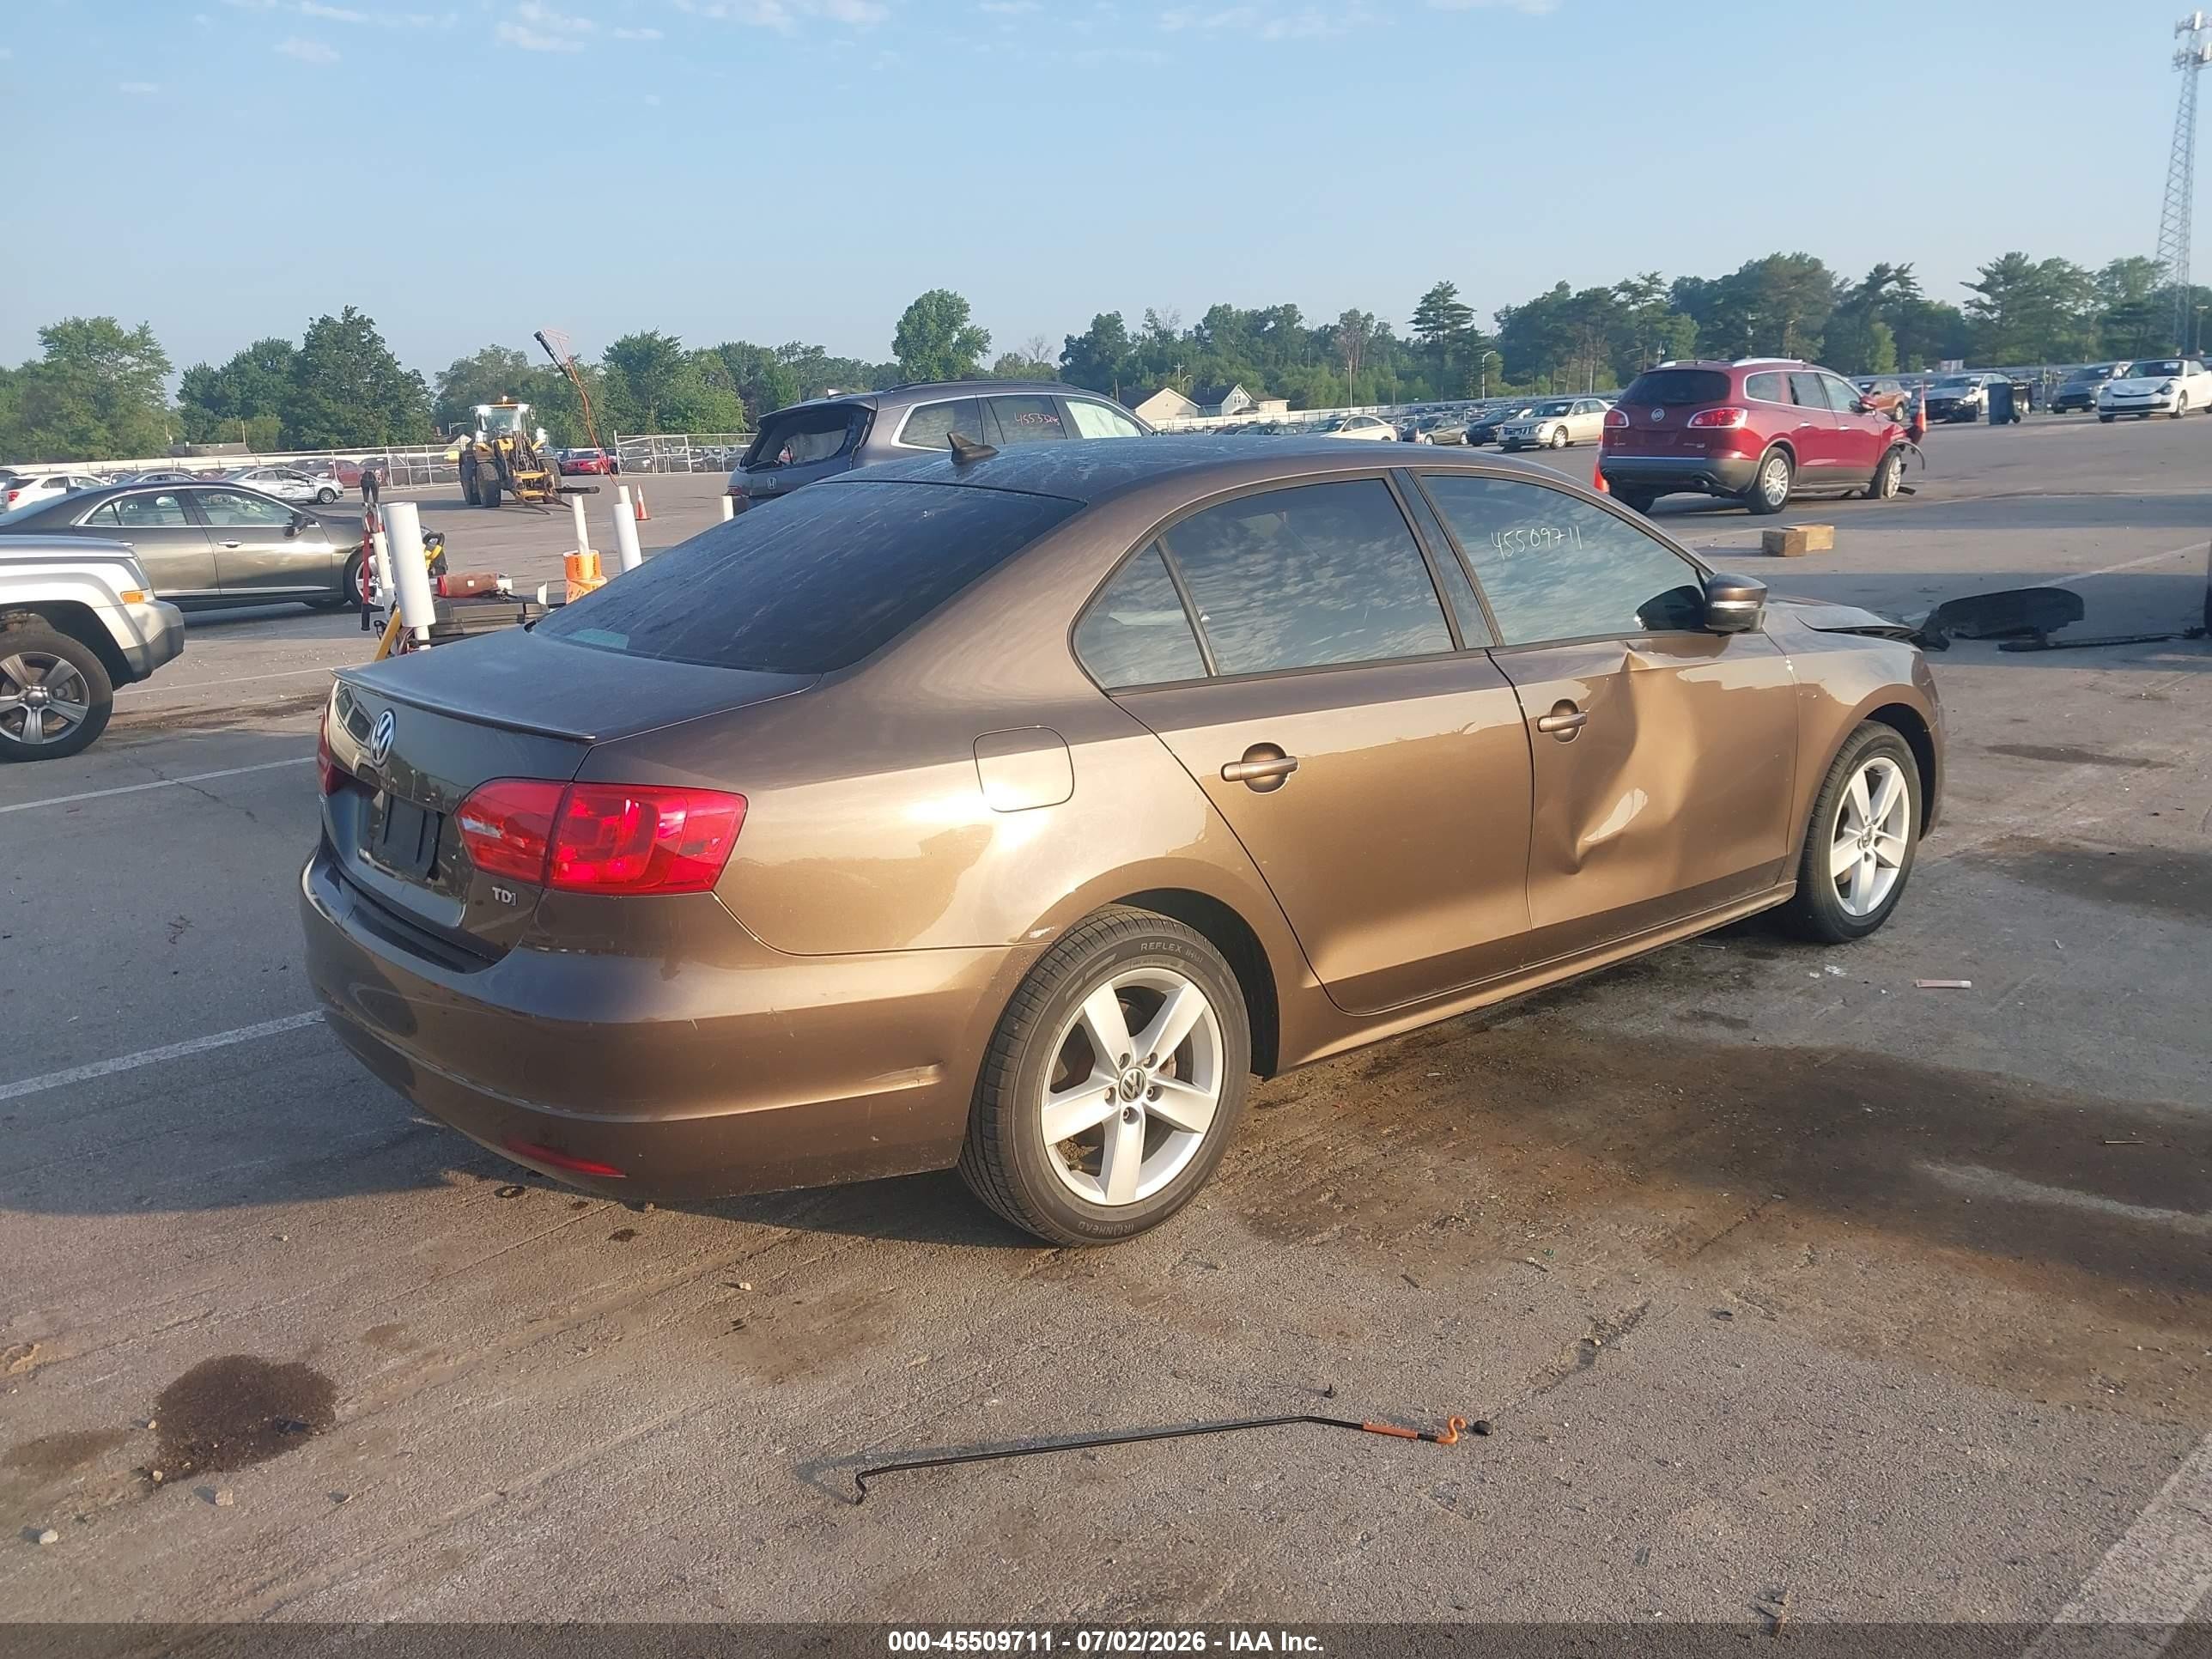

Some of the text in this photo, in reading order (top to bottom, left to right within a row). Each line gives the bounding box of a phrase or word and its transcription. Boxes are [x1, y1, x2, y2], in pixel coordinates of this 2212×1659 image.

[1491, 525, 1582, 561] 45509711
[491, 886, 516, 906] TDI
[1140, 941, 1182, 954] REFLEX
